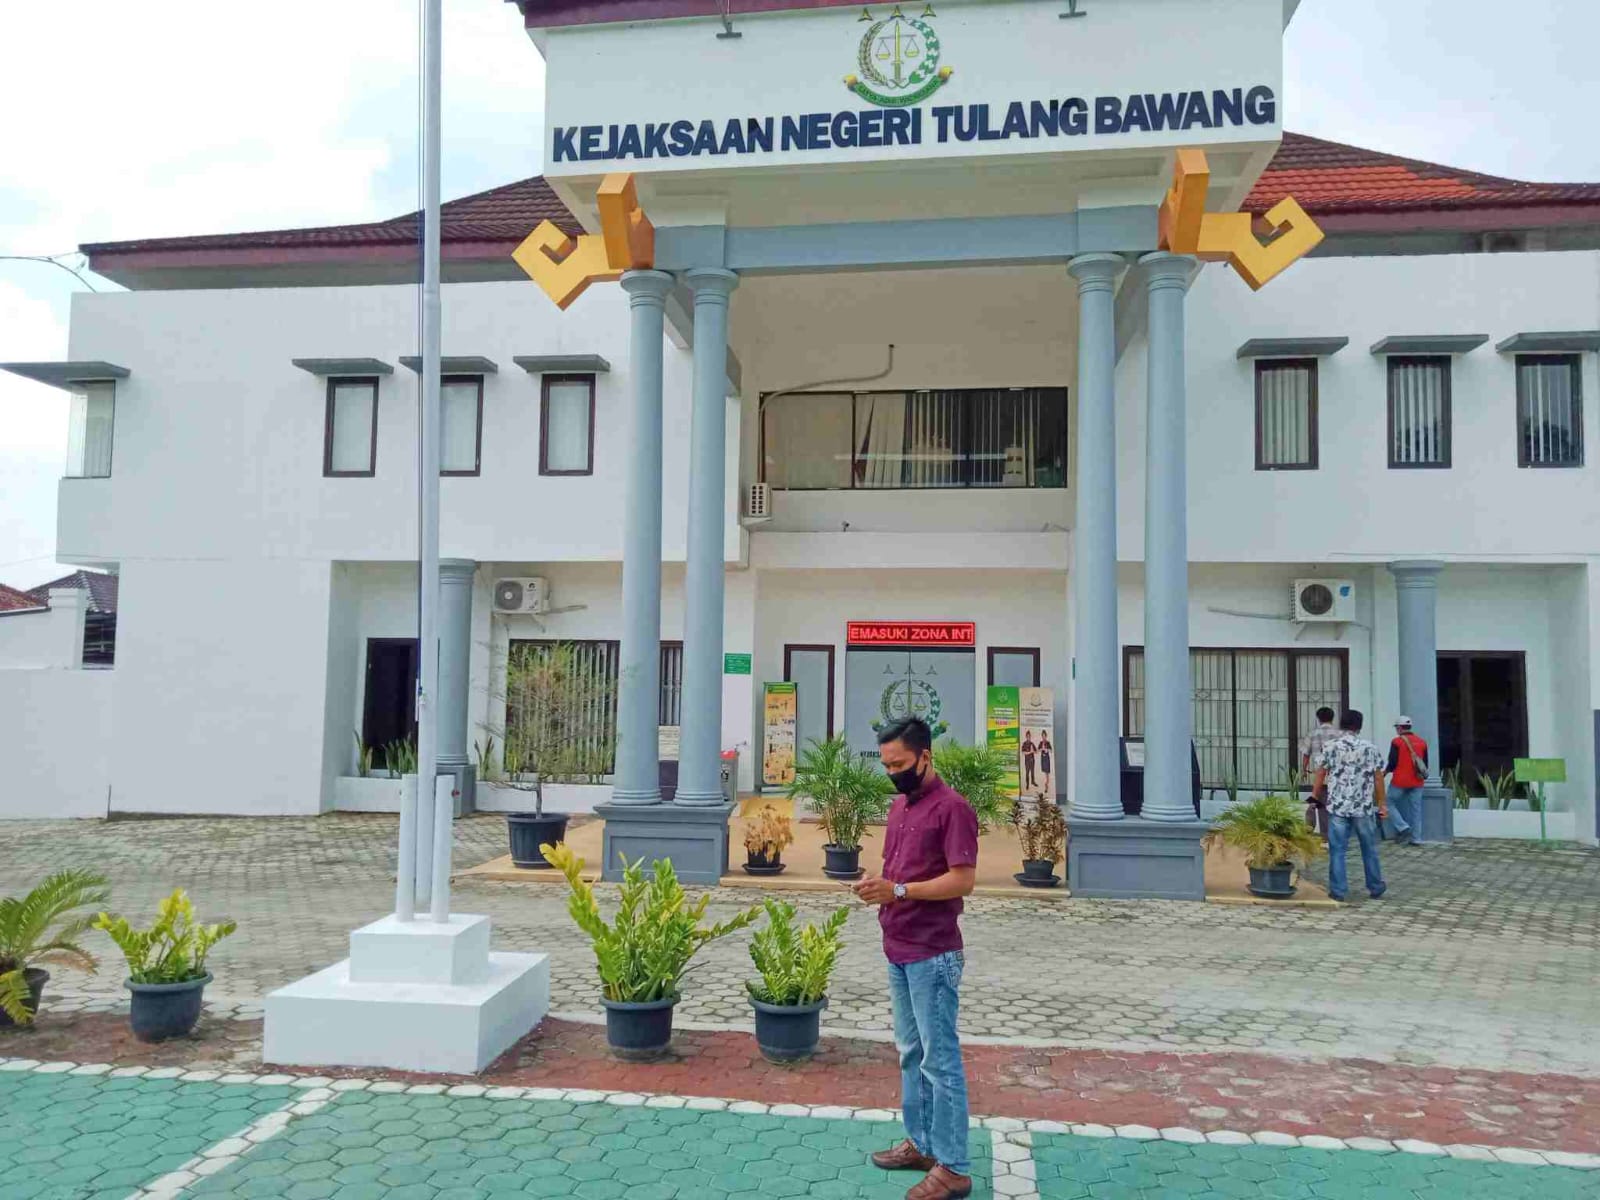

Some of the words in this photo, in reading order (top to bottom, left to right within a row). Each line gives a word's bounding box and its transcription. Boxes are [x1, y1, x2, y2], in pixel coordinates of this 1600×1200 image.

[553, 117, 774, 162] KEJAKSAAN
[781, 108, 921, 151] NEGERI
[932, 97, 1088, 143] TULANG
[1094, 85, 1275, 134] BAWANG
[850, 627, 908, 640] EMASUKI
[911, 628, 949, 640] ZONA
[951, 628, 972, 640] INT
